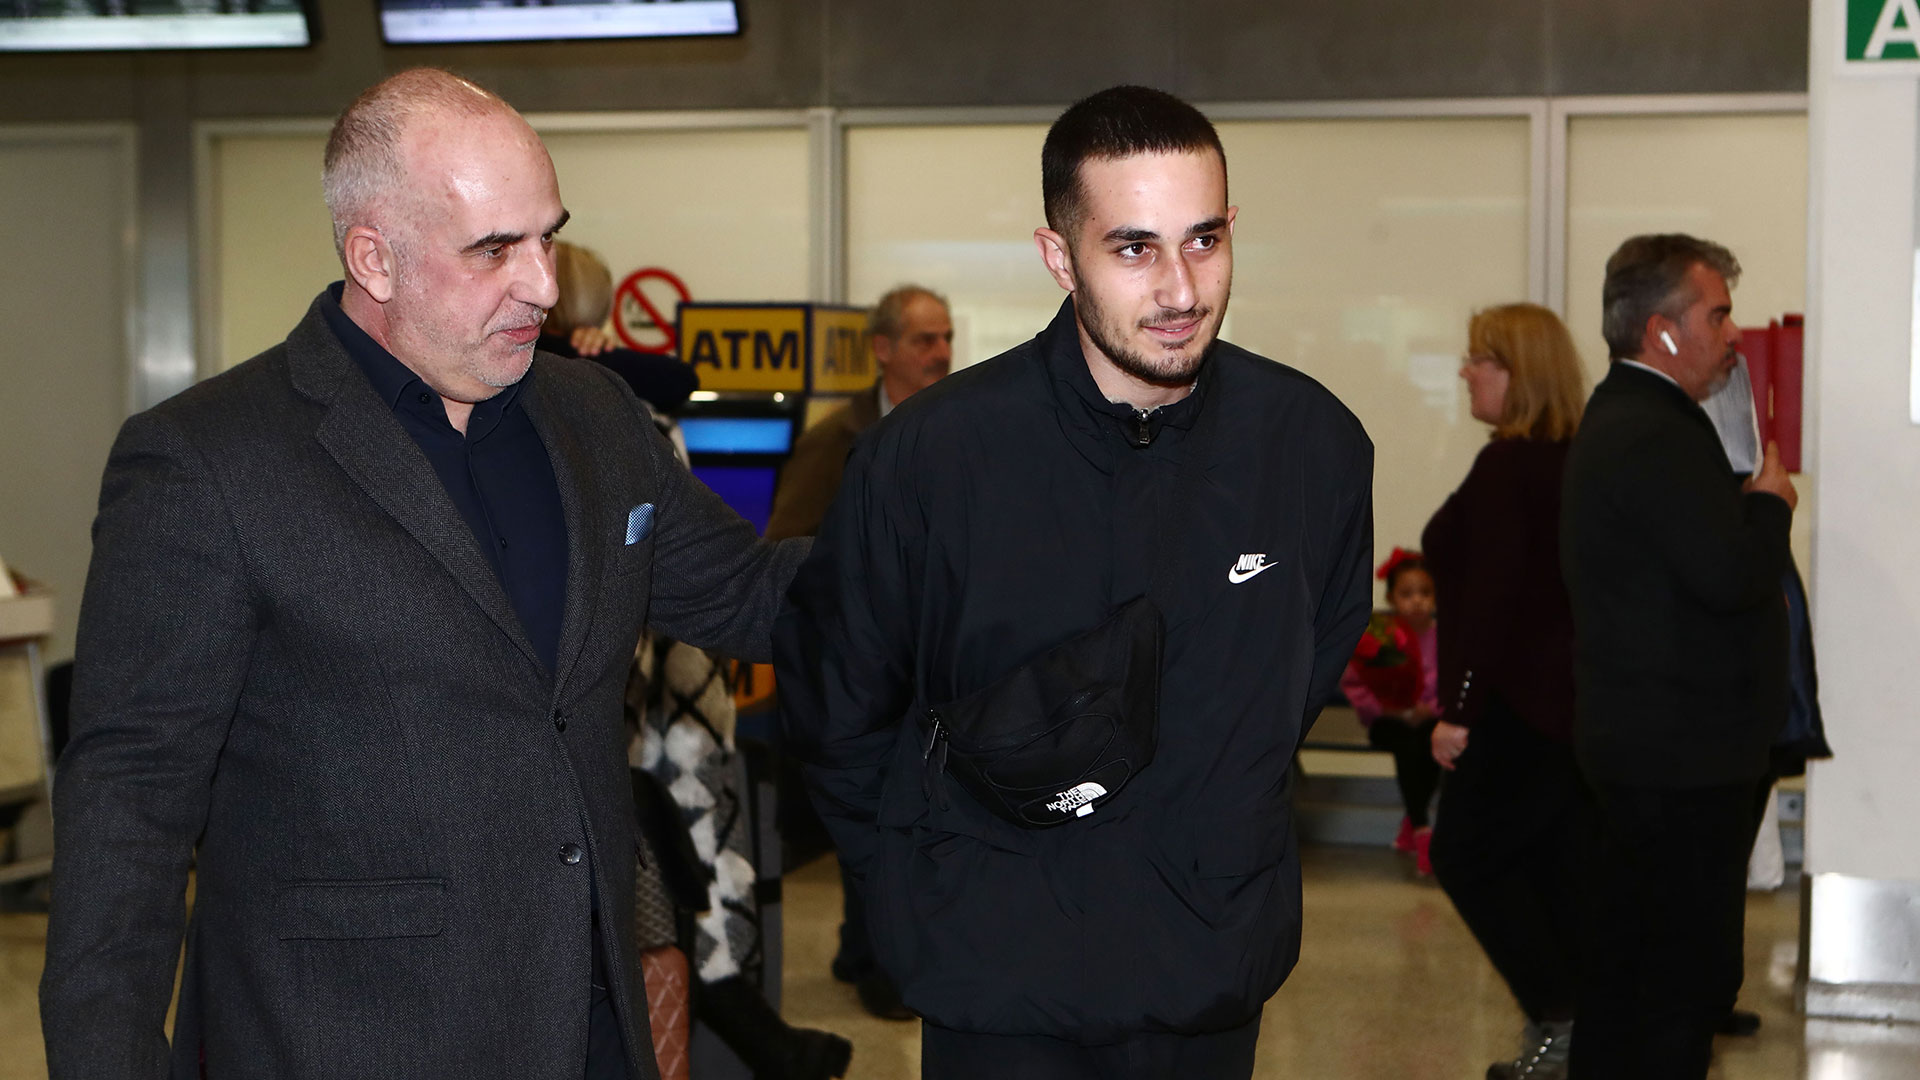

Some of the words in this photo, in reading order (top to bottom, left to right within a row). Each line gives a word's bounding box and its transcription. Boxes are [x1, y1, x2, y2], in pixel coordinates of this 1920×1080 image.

[1863, 0, 1920, 61] A
[689, 330, 799, 370] ATM
[1236, 553, 1267, 570] NIKE
[1046, 793, 1085, 811] NORTH
[1055, 787, 1081, 801] THE
[1061, 797, 1089, 813] FACE
